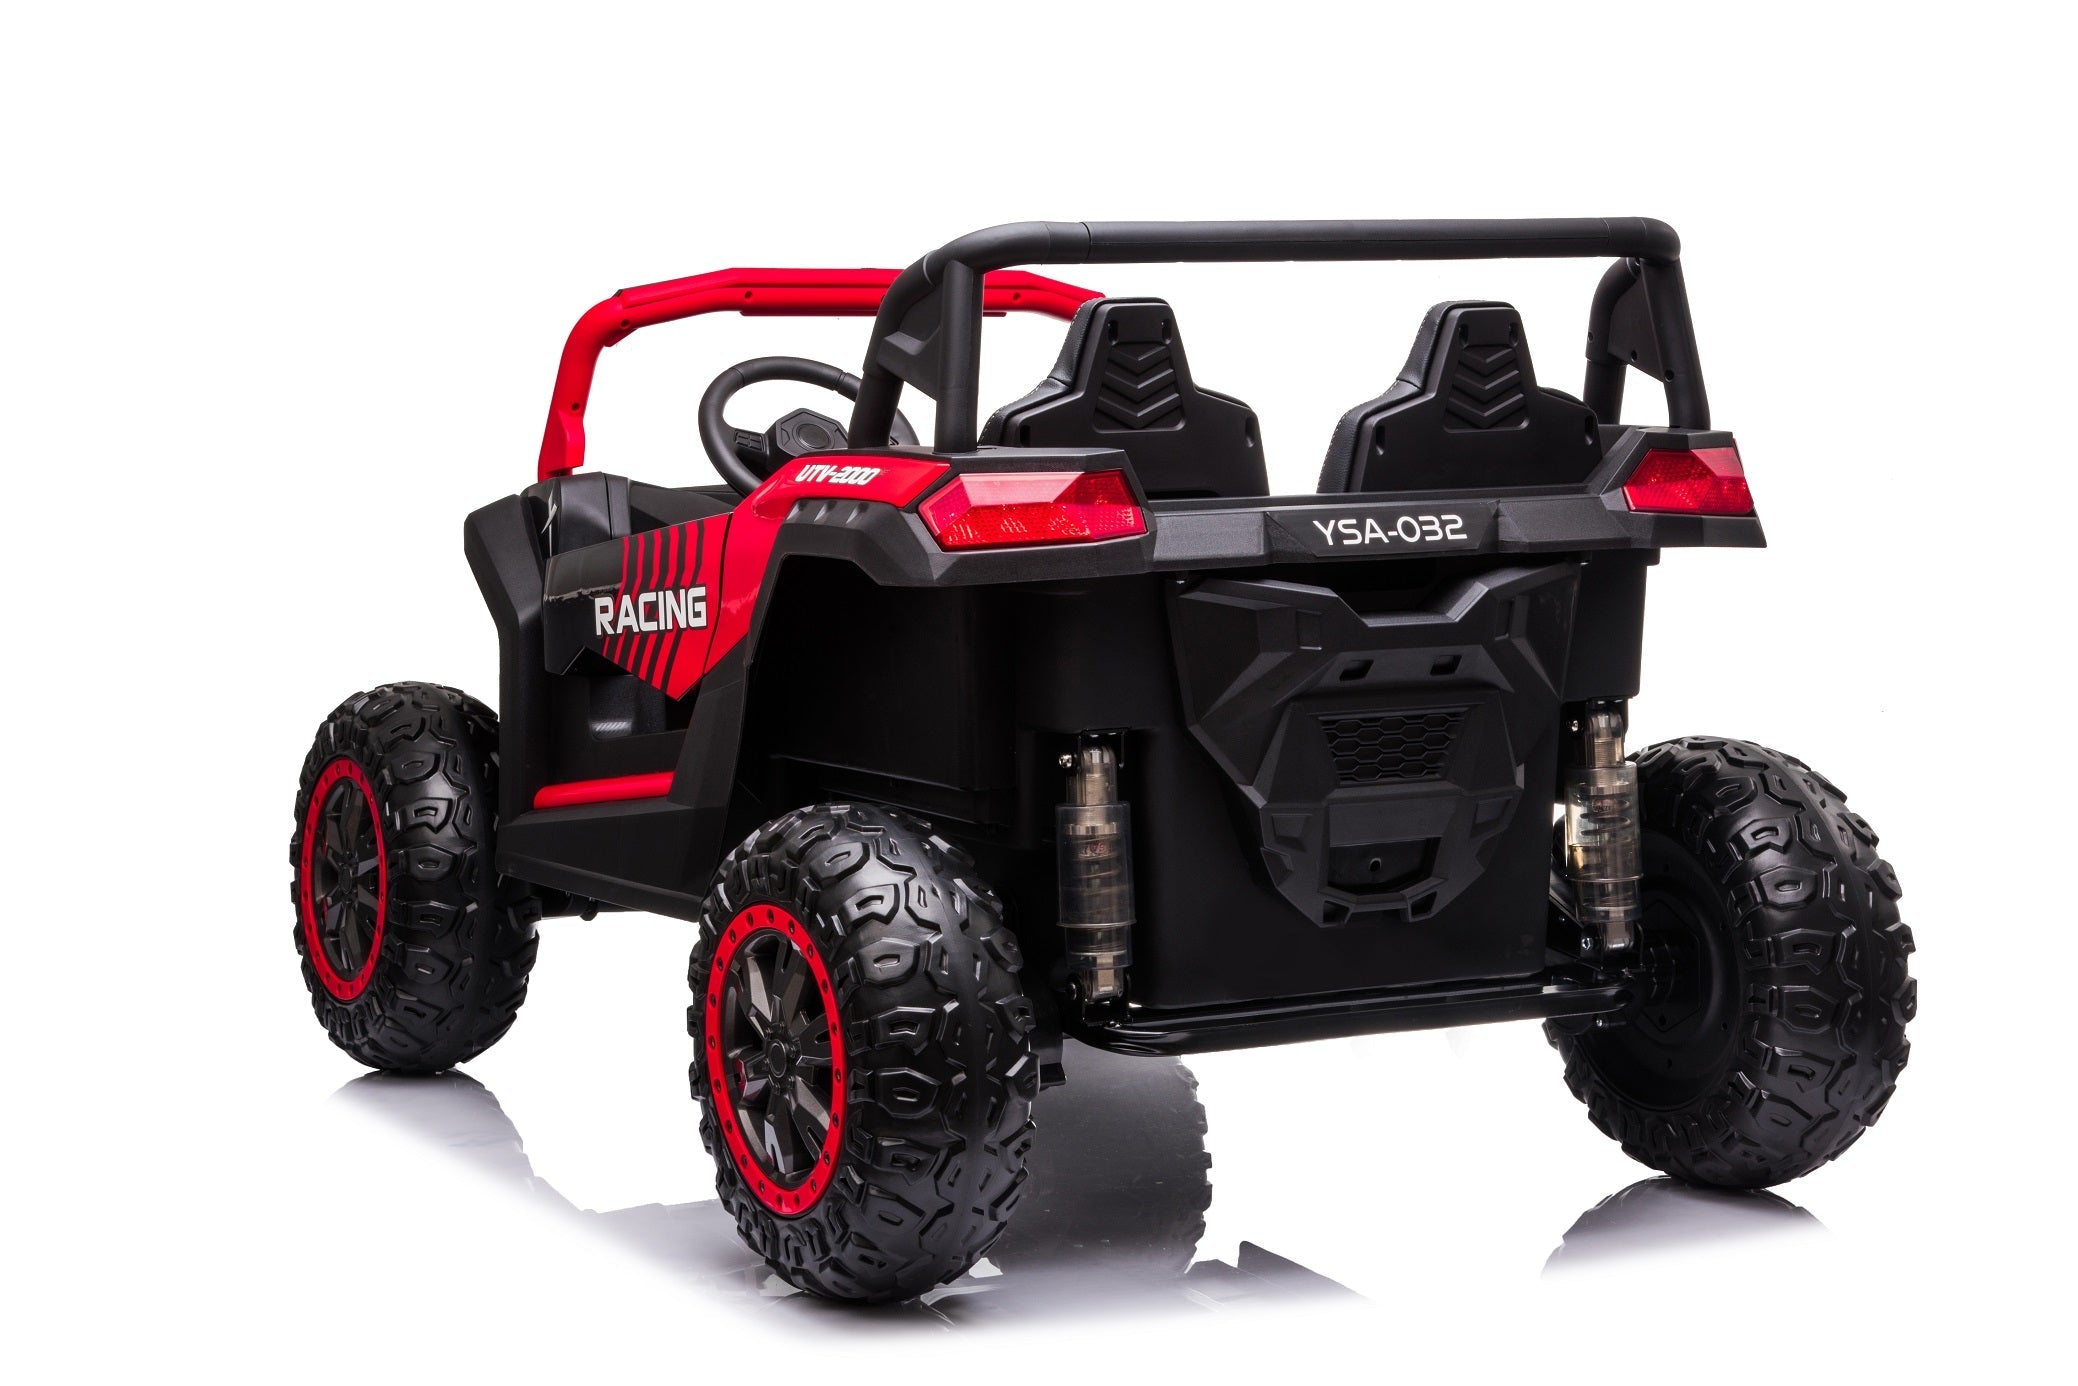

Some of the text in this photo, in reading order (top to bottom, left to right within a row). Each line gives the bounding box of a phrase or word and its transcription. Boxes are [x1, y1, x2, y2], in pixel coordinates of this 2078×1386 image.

[794, 464, 881, 486] UTV-2000
[1312, 514, 1468, 546] YSA-032
[594, 586, 707, 636] RACING
